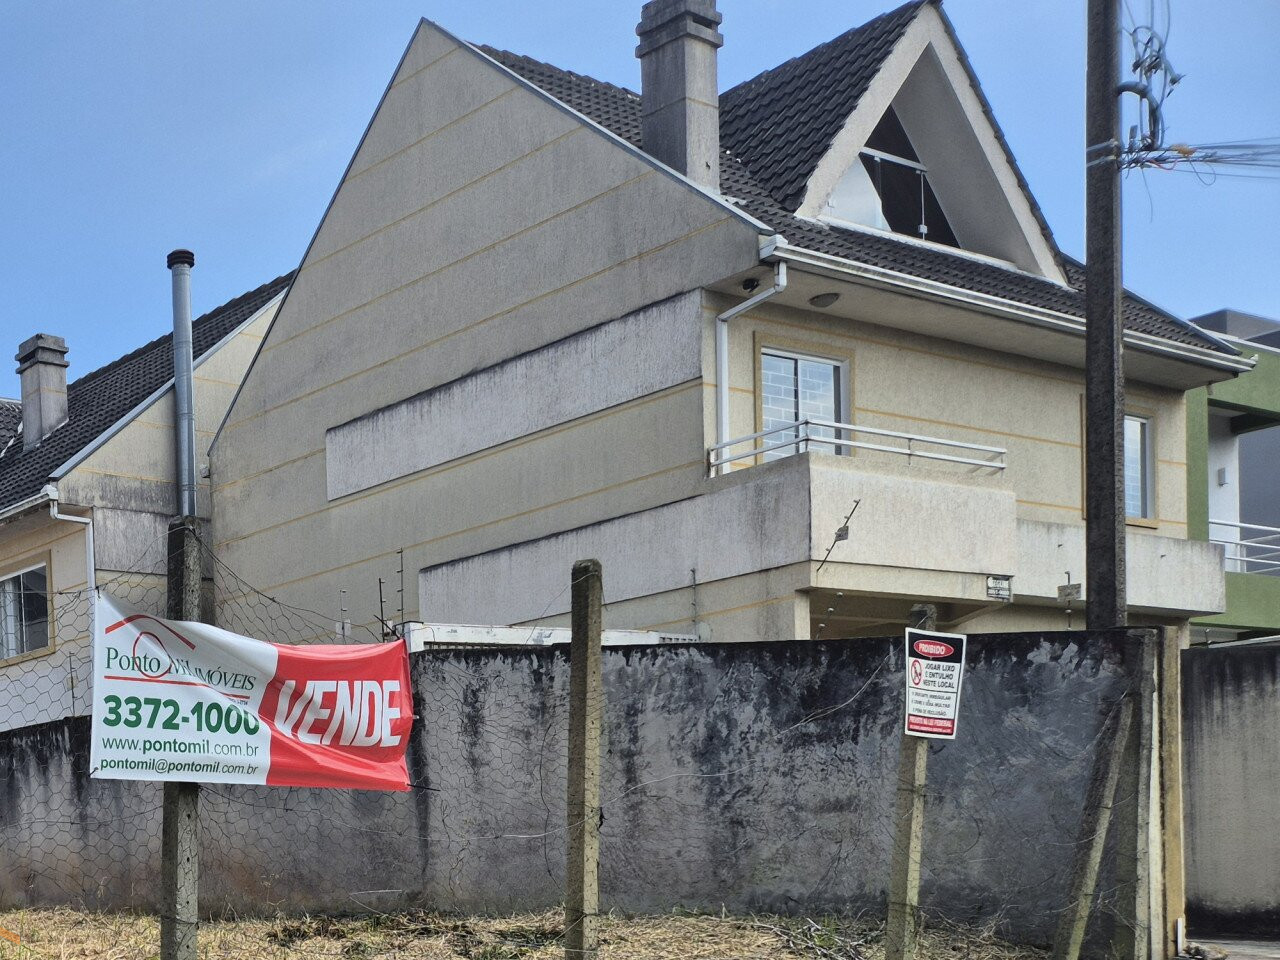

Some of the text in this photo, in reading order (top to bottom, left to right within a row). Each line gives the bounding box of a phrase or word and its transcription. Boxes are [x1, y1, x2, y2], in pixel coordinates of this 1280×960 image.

[105, 647, 161, 673] Ponto
[102, 694, 260, 735] 3372-1000
[274, 679, 402, 747] VENDE
[101, 736, 259, 757] www.pontomil.com.br
[100, 758, 258, 774] pontomil@pontomil.com.br
